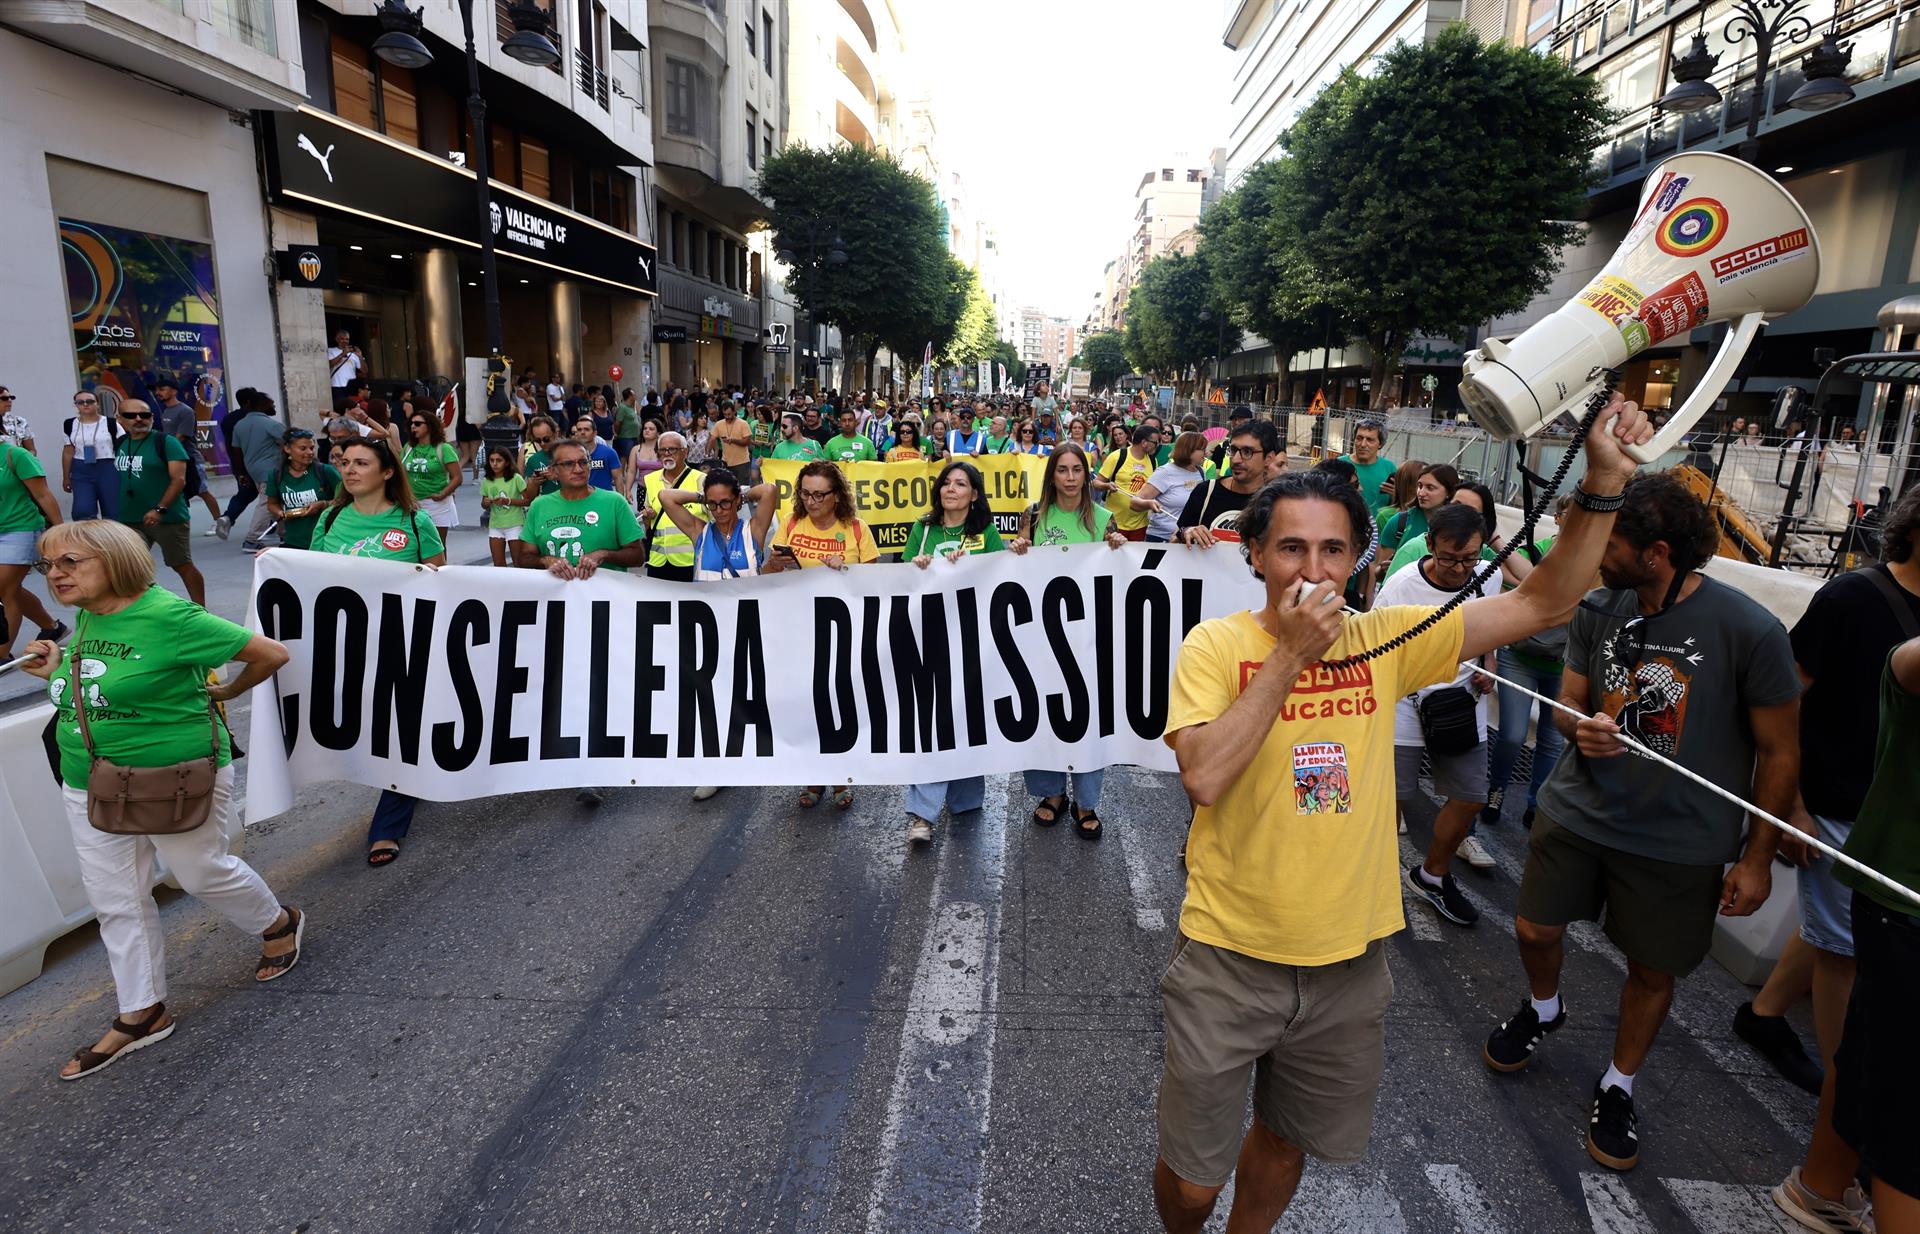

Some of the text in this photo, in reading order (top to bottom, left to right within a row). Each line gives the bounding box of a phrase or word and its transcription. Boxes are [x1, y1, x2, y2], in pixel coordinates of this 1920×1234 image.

[505, 206, 567, 244] VALENCIA CF
[506, 228, 546, 250] OFFICIAL STORE
[1715, 242, 1777, 273] CCOO
[1719, 257, 1779, 285] país valencià
[93, 324, 136, 339] IQOS
[170, 330, 201, 342] VEEV
[119, 340, 141, 349] TABACO
[591, 459, 605, 468] ESEL
[855, 476, 929, 511] ESCO
[546, 514, 592, 528] ESTIME
[878, 513, 1022, 546] MÉS ENCI
[384, 531, 407, 544] UGT
[791, 536, 828, 550] CCOO
[70, 639, 134, 660] TIMEM
[1629, 641, 1686, 655] PALTINA LLIURE
[257, 577, 774, 772] CONSELLERA
[1280, 688, 1378, 722] ucació
[1293, 745, 1343, 757] LLUITAR
[1308, 755, 1345, 766] EDUCAR
